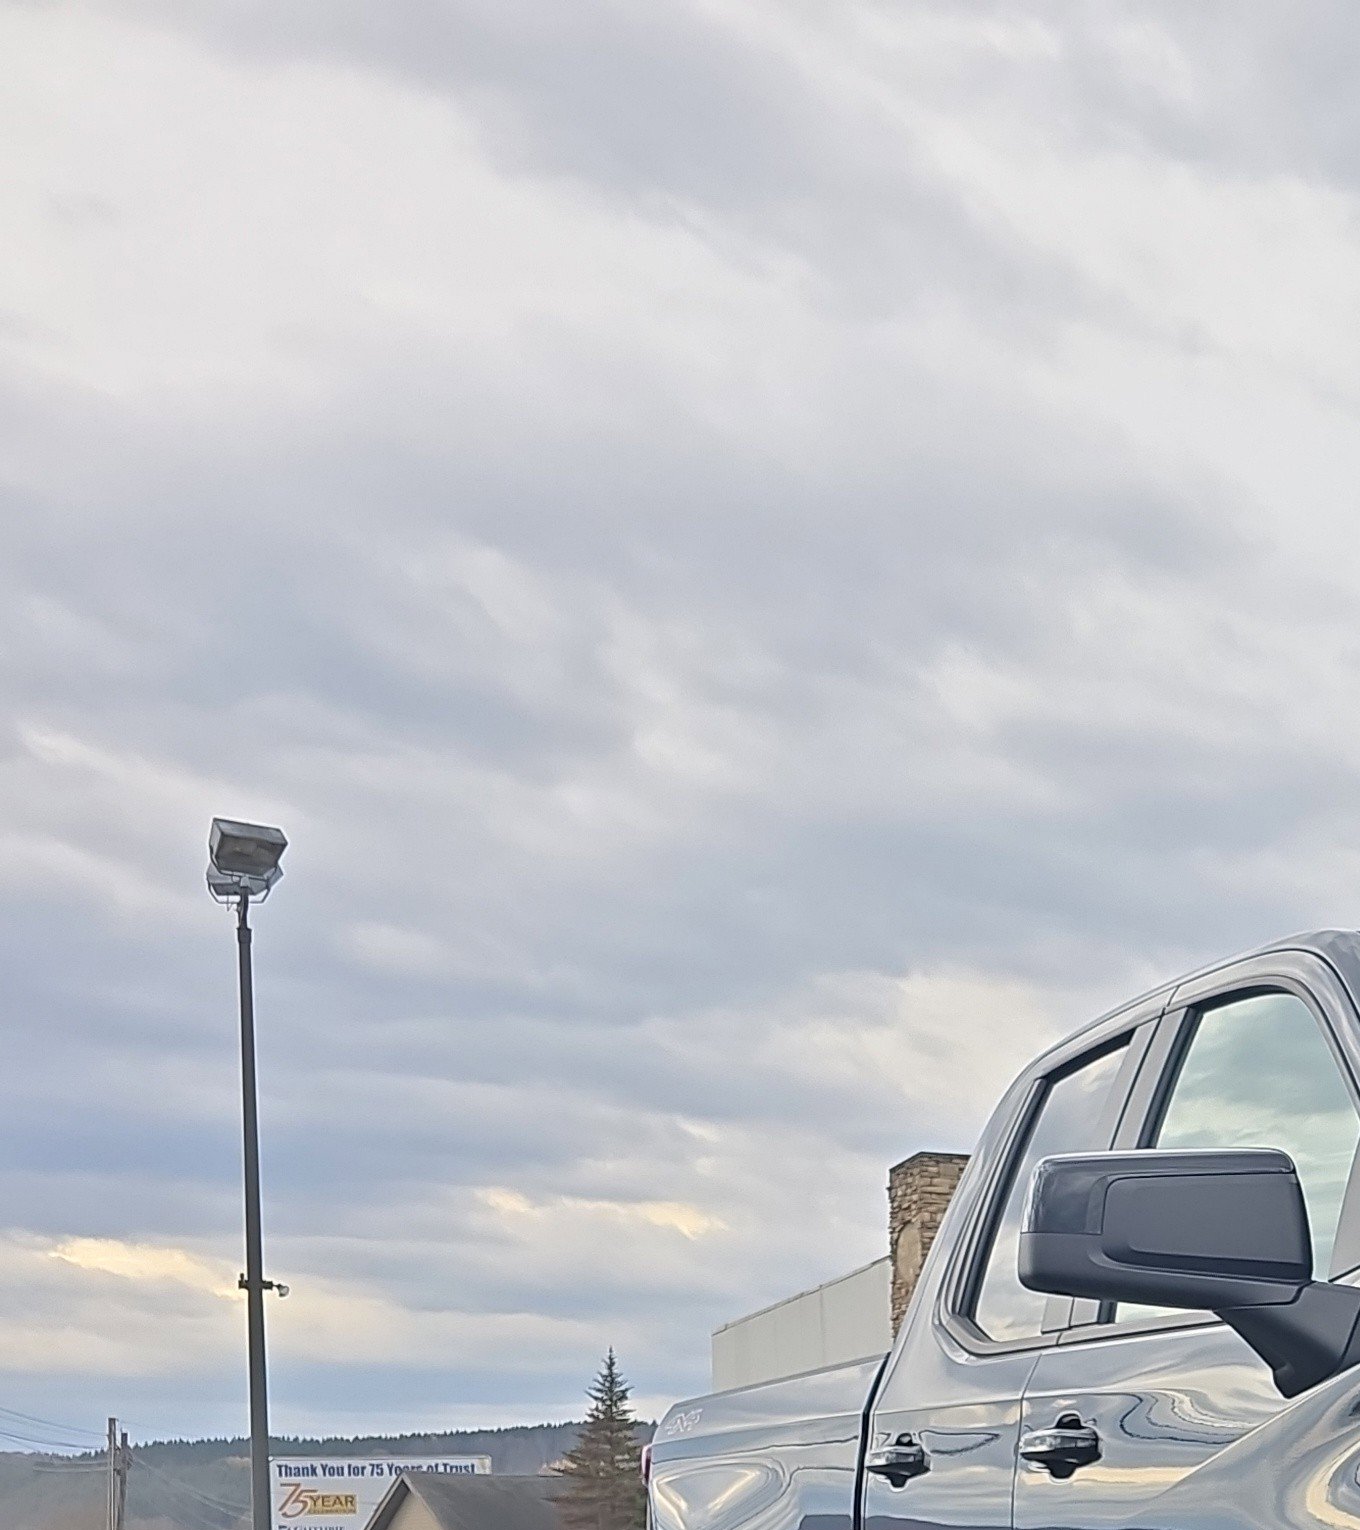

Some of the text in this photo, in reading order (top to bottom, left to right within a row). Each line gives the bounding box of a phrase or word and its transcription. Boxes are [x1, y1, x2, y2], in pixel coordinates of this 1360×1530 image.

[276, 1463, 318, 1478] Thank
[320, 1463, 344, 1477] You
[347, 1463, 366, 1477] for
[368, 1463, 384, 1477] 75
[442, 1462, 476, 1475] Trust
[278, 1482, 356, 1518] 75 YEAR
